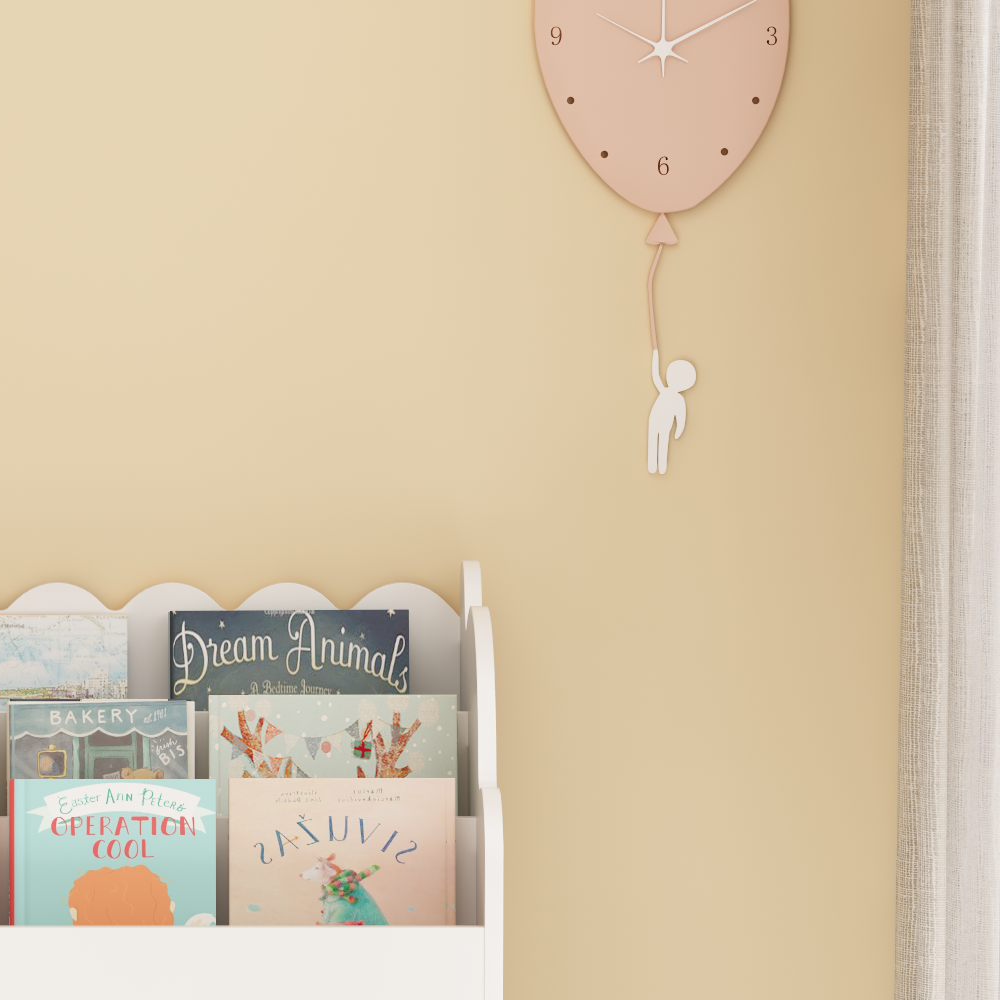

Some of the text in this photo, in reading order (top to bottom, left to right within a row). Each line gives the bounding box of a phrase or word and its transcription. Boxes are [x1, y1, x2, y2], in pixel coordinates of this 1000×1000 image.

[550, 26, 563, 46] 9
[766, 26, 778, 46] 3
[657, 156, 670, 176] 6
[173, 610, 409, 696] Dream Animals
[250, 678, 332, 695] A Bedtime Journey
[50, 708, 138, 725] BAKERY
[155, 738, 178, 756] fresh
[158, 745, 186, 766] BIS
[51, 816, 196, 836] OPERATION
[92, 838, 155, 860] COOL
